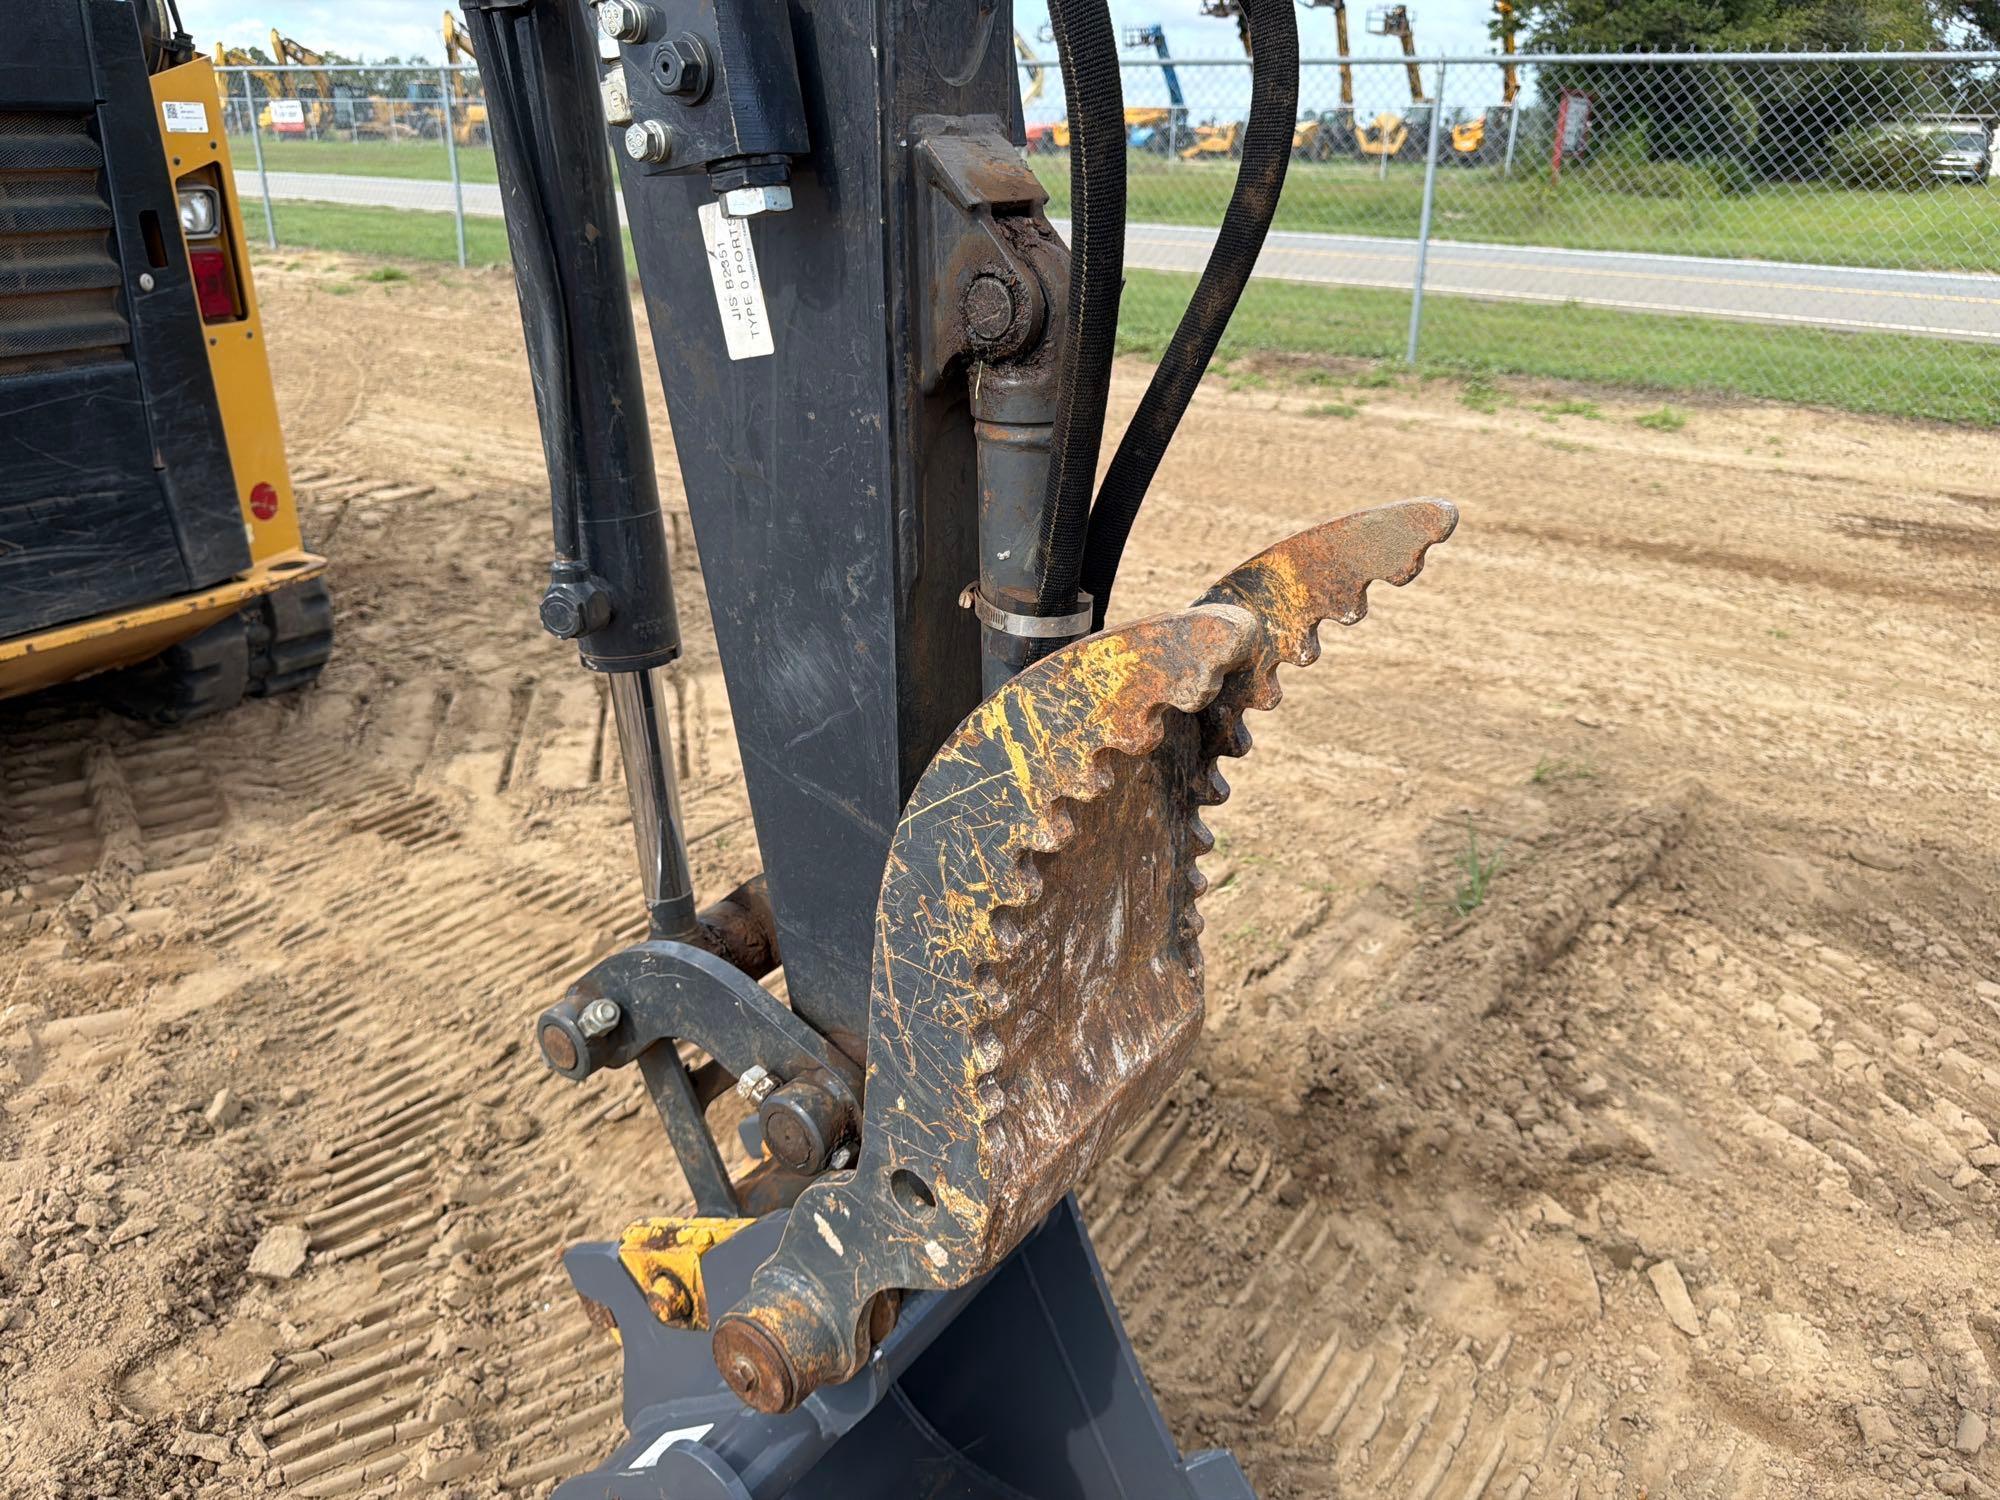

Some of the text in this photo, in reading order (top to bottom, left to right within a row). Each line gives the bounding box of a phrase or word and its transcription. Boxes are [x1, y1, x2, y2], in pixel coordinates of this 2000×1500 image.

[727, 218, 746, 273] PORTS
[717, 242, 741, 320] JIS B2351
[743, 296, 760, 340] TYPE
